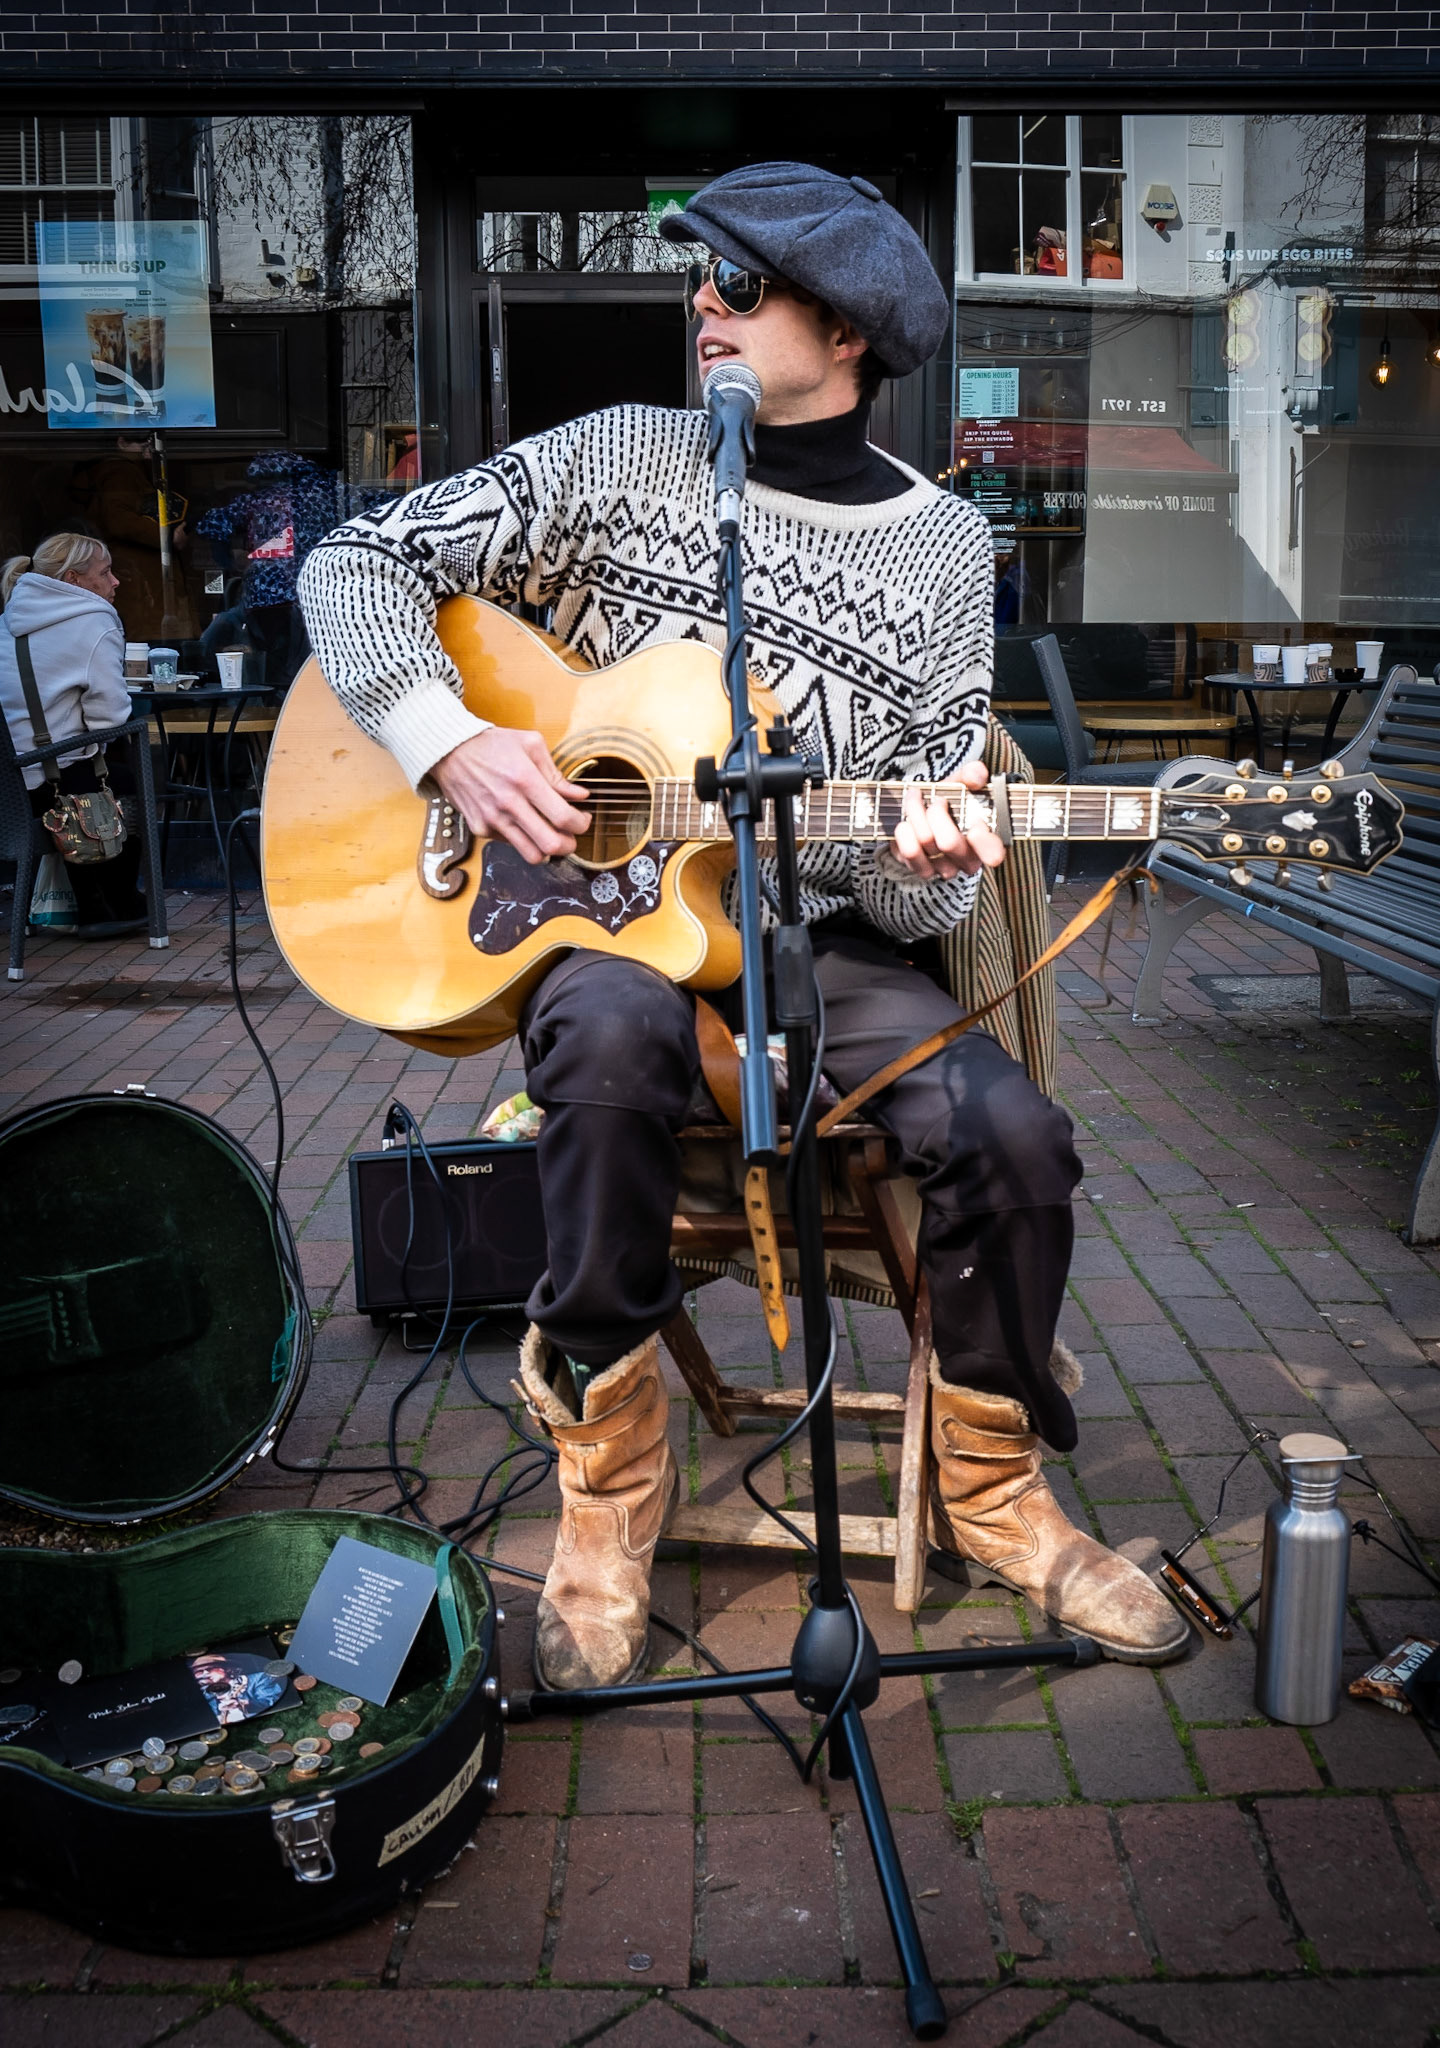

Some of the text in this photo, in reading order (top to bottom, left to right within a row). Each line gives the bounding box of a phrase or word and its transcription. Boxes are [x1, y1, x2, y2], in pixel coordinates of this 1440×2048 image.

[1206, 247, 1354, 262] SOUS VIDE EGG BITES
[78, 260, 167, 274] THINGS UP
[992, 371, 1012, 379] HOURS
[1353, 788, 1374, 856] Epiphone
[447, 1163, 493, 1176] Roland
